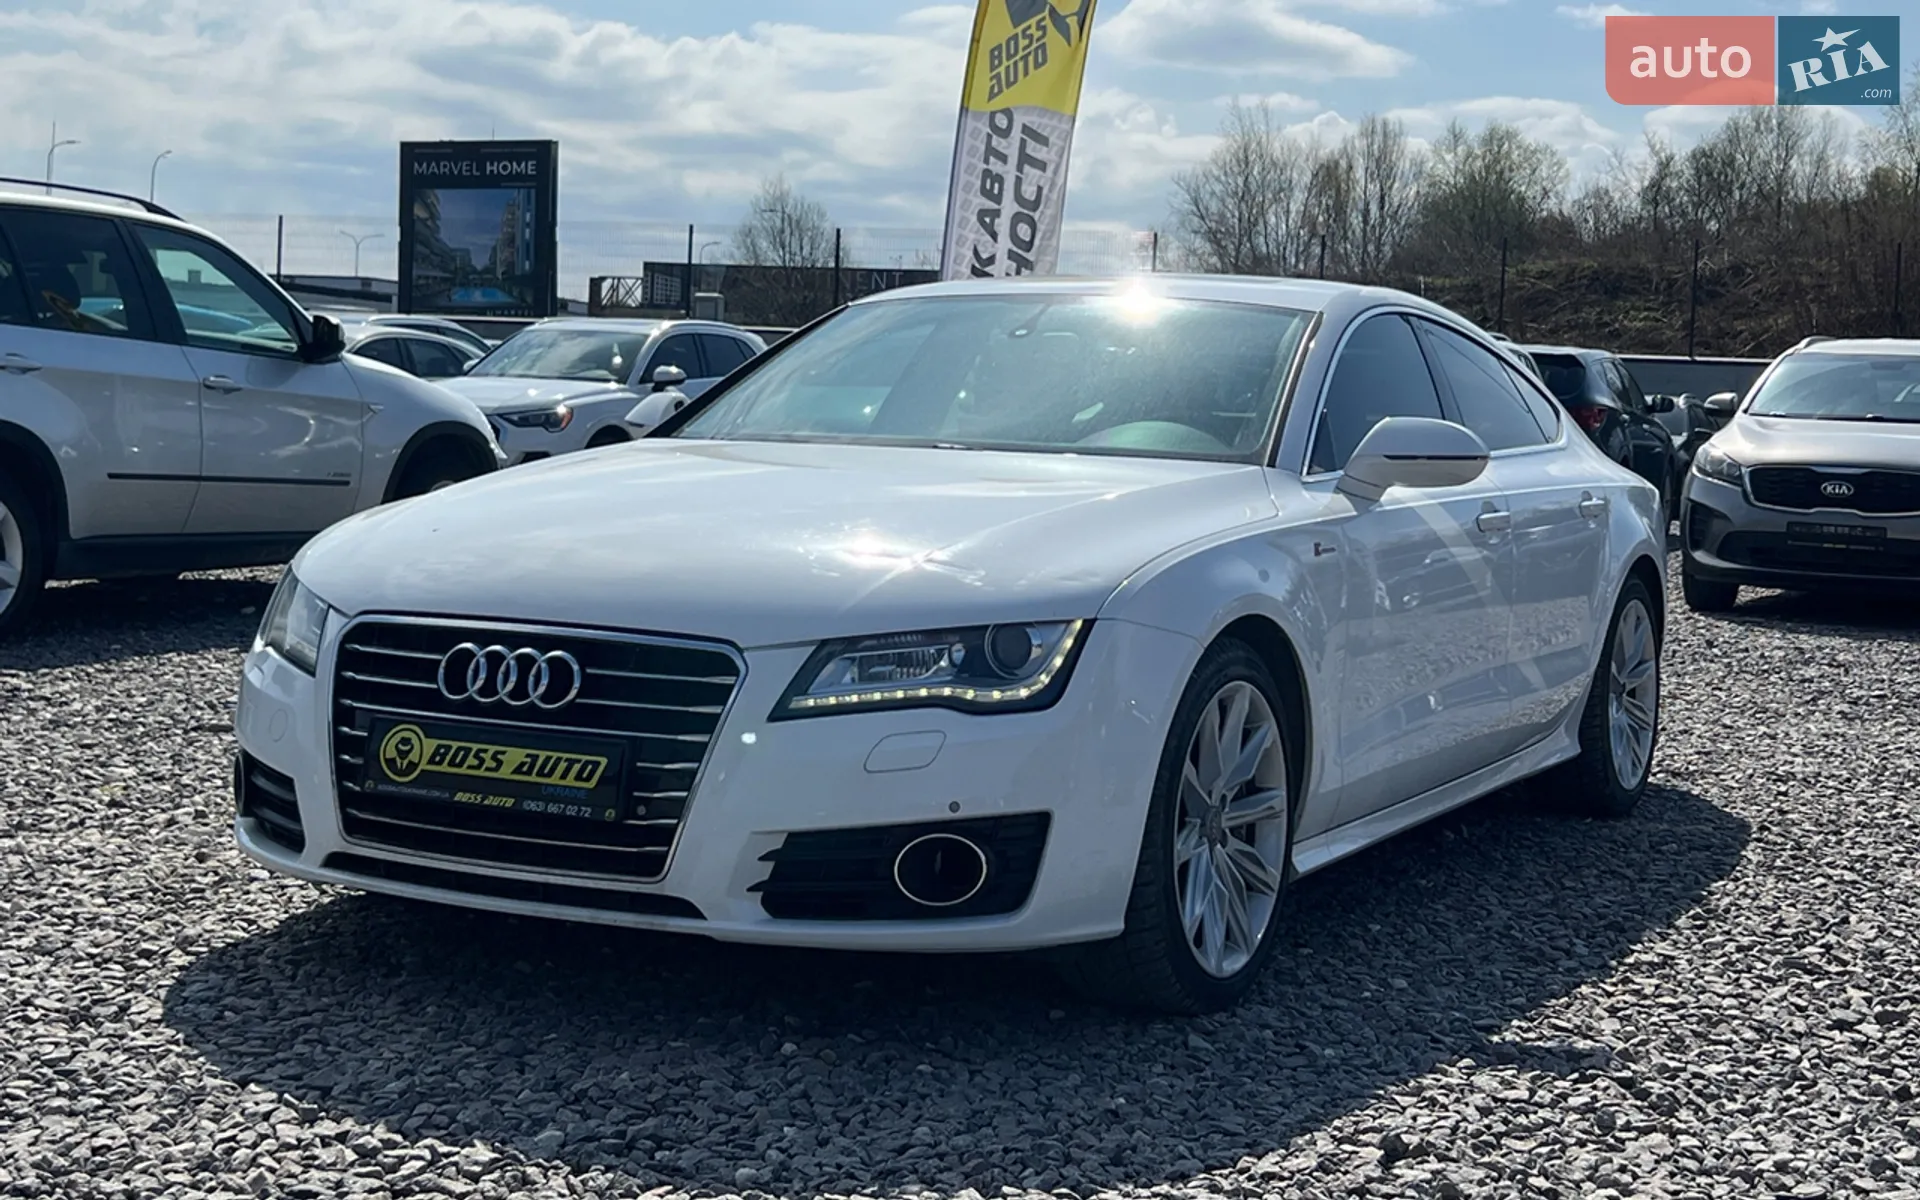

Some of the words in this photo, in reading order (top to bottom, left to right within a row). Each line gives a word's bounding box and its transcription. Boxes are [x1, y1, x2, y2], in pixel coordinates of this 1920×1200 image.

[989, 15, 1048, 74] BOSS
[987, 42, 1049, 103] AUTO
[413, 160, 480, 176] MARVEL
[485, 160, 537, 176] HOME
[1825, 484, 1849, 495] KIA
[426, 743, 507, 773] BOSS
[510, 752, 603, 783] AUTO
[453, 791, 482, 804] BOSS
[483, 796, 516, 808] AUTO
[547, 802, 565, 814] 667
[565, 804, 578, 817] 02
[579, 806, 592, 818] 72
